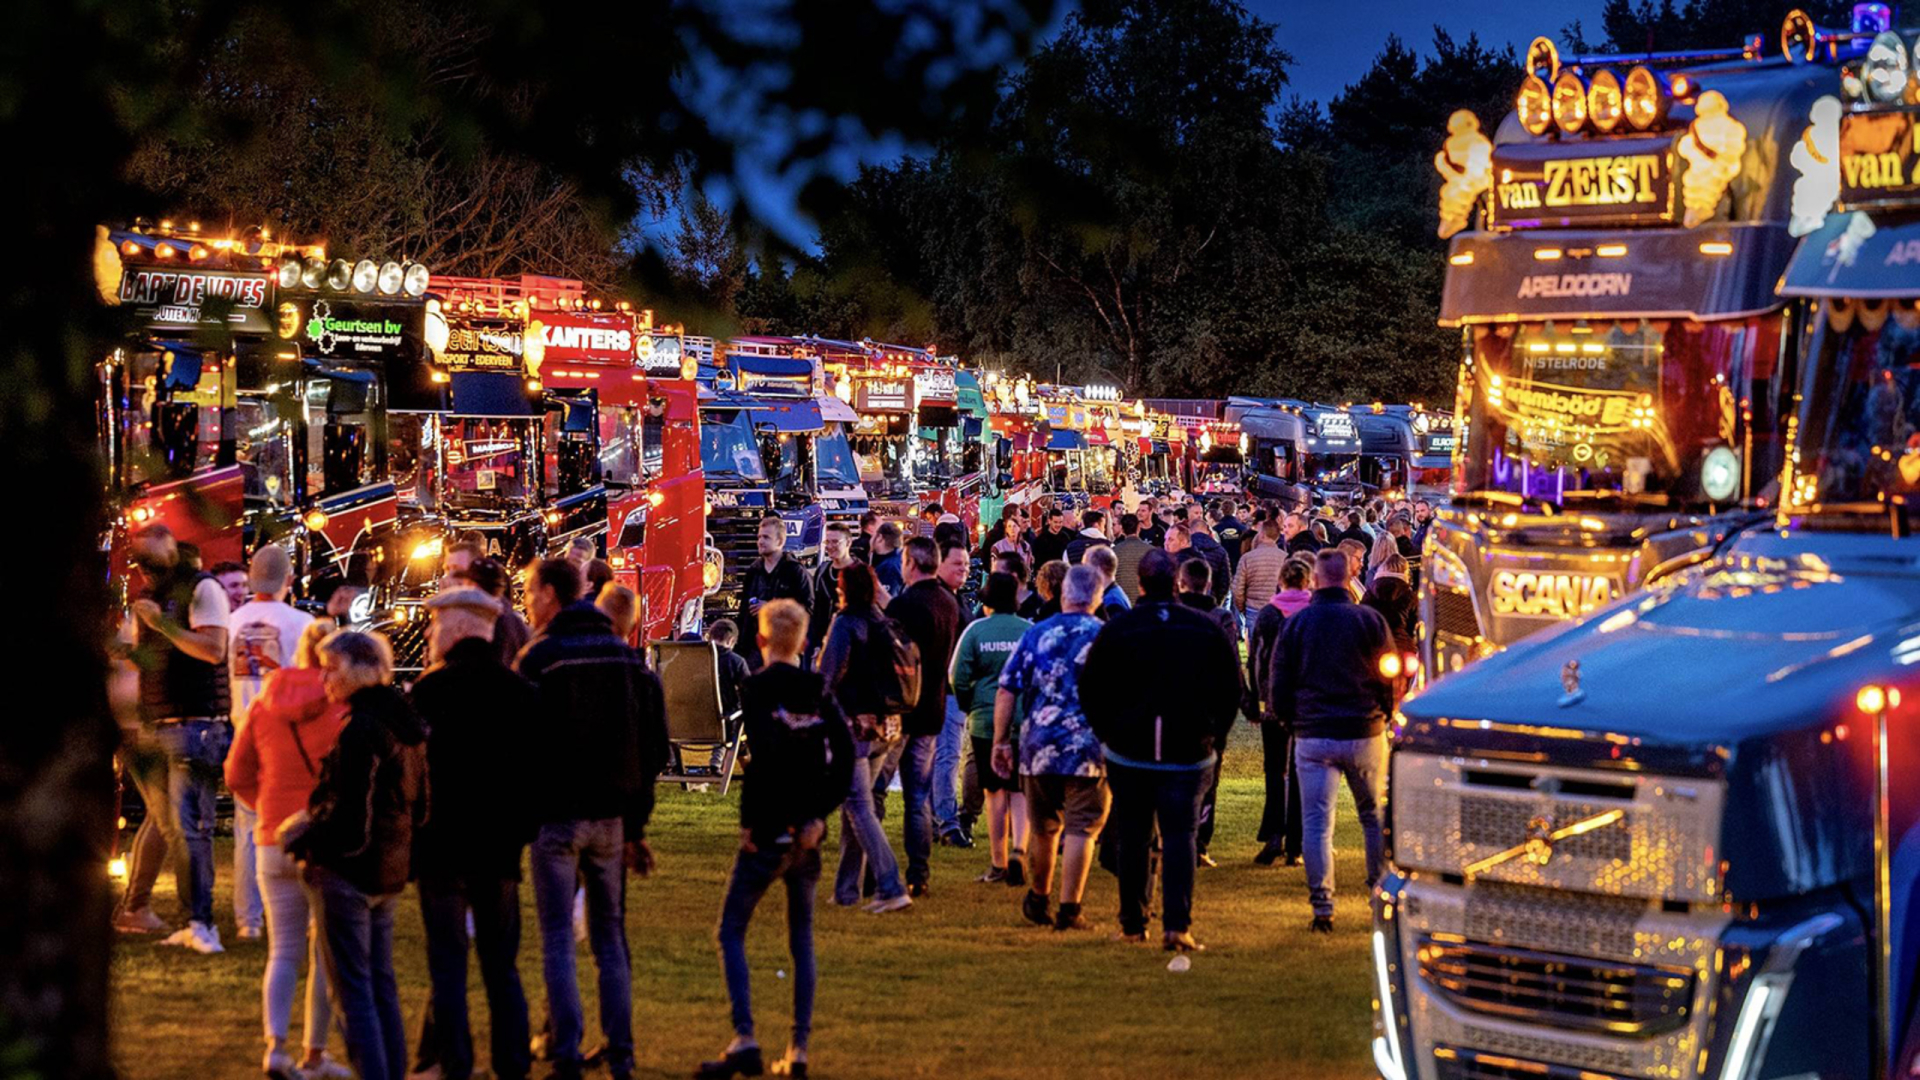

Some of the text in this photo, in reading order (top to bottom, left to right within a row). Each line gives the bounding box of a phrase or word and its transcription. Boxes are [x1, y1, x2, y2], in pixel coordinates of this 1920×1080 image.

[1497, 154, 1659, 209] van ZEIST
[1843, 152, 1904, 188] van
[173, 274, 205, 306] DE
[207, 276, 266, 308] VRIES
[1517, 272, 1632, 298] APELDOORN
[153, 305, 188, 322] PUTTEN
[325, 317, 402, 334] Geurtsen bv
[540, 325, 631, 351] KANTERS
[1523, 357, 1606, 370] NISTELRODE
[1493, 571, 1609, 617] SCANIA
